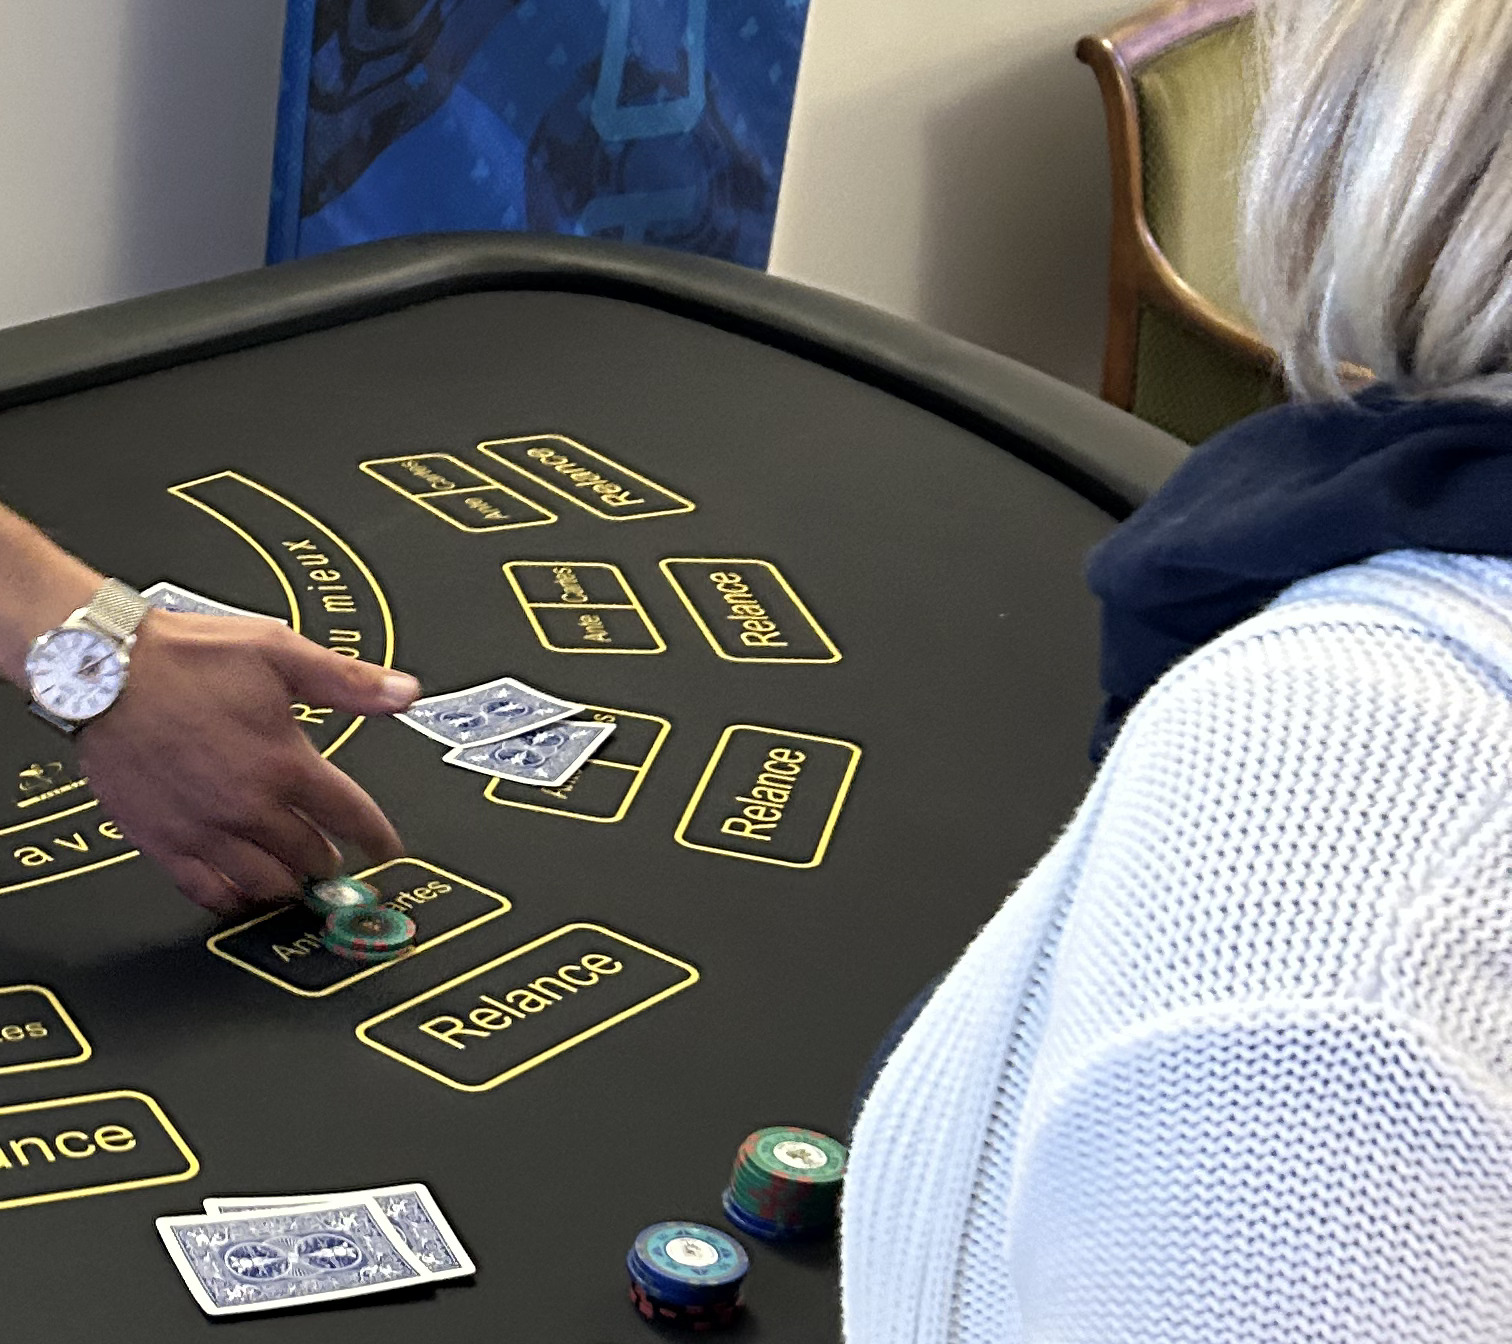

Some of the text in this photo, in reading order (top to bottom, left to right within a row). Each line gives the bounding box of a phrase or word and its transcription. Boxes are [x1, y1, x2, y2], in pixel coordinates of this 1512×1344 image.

[526, 447, 645, 507] Relance
[709, 571, 788, 647] Relance
[13, 820, 125, 867] ave
[281, 539, 357, 613] mieux
[720, 747, 807, 841] Relance
[384, 880, 452, 913] artes
[419, 950, 623, 1050] Relance
